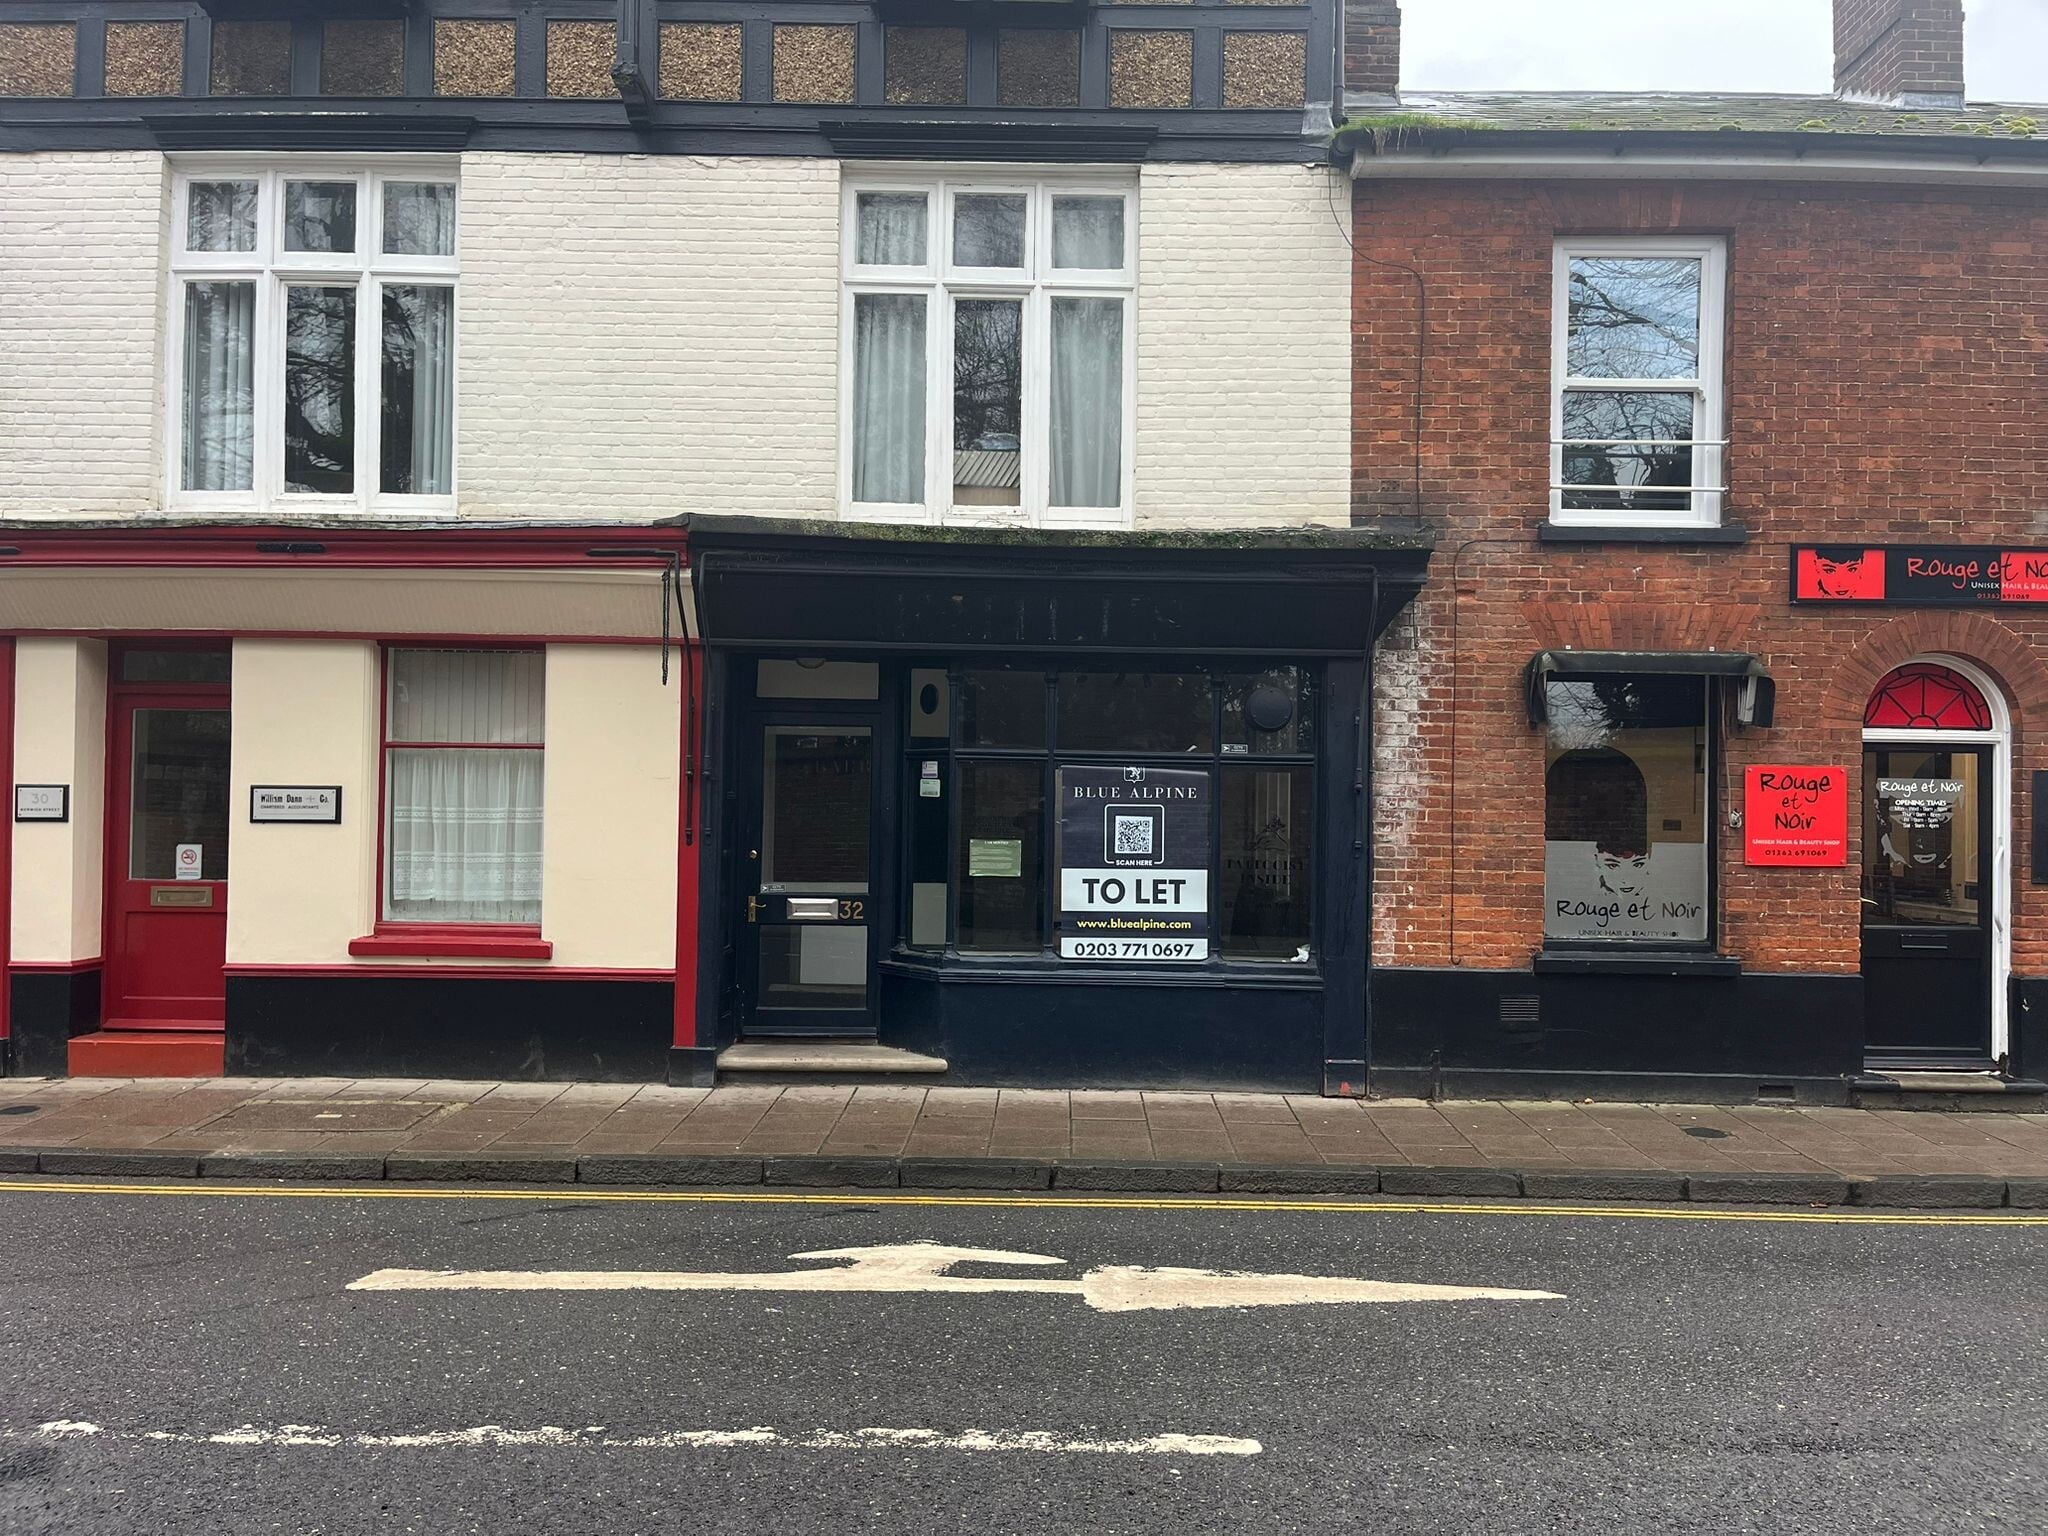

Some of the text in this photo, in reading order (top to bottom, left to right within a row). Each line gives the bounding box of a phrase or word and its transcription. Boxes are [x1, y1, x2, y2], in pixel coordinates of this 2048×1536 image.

[1907, 557, 1980, 589] Rouge
[1987, 553, 2019, 581] et
[1970, 581, 2000, 589] UNISEX
[2002, 582, 2021, 590] HAIR
[1073, 786, 1198, 800] BLUE ALPINE
[1760, 773, 1833, 803] Rouge
[1880, 779, 1964, 798] Rouge et Noir
[31, 793, 49, 804] 30
[260, 793, 283, 803] William
[1782, 792, 1802, 810] et
[1775, 811, 1817, 830] Noir
[1765, 849, 1828, 857] 01362 691069
[1082, 878, 1187, 905] TO LET
[839, 900, 864, 920] 32
[1556, 897, 1702, 928] Rouge et Noir
[1076, 918, 1192, 931] www.bluealpine.com
[1074, 943, 1195, 958] 0203 771 0697
